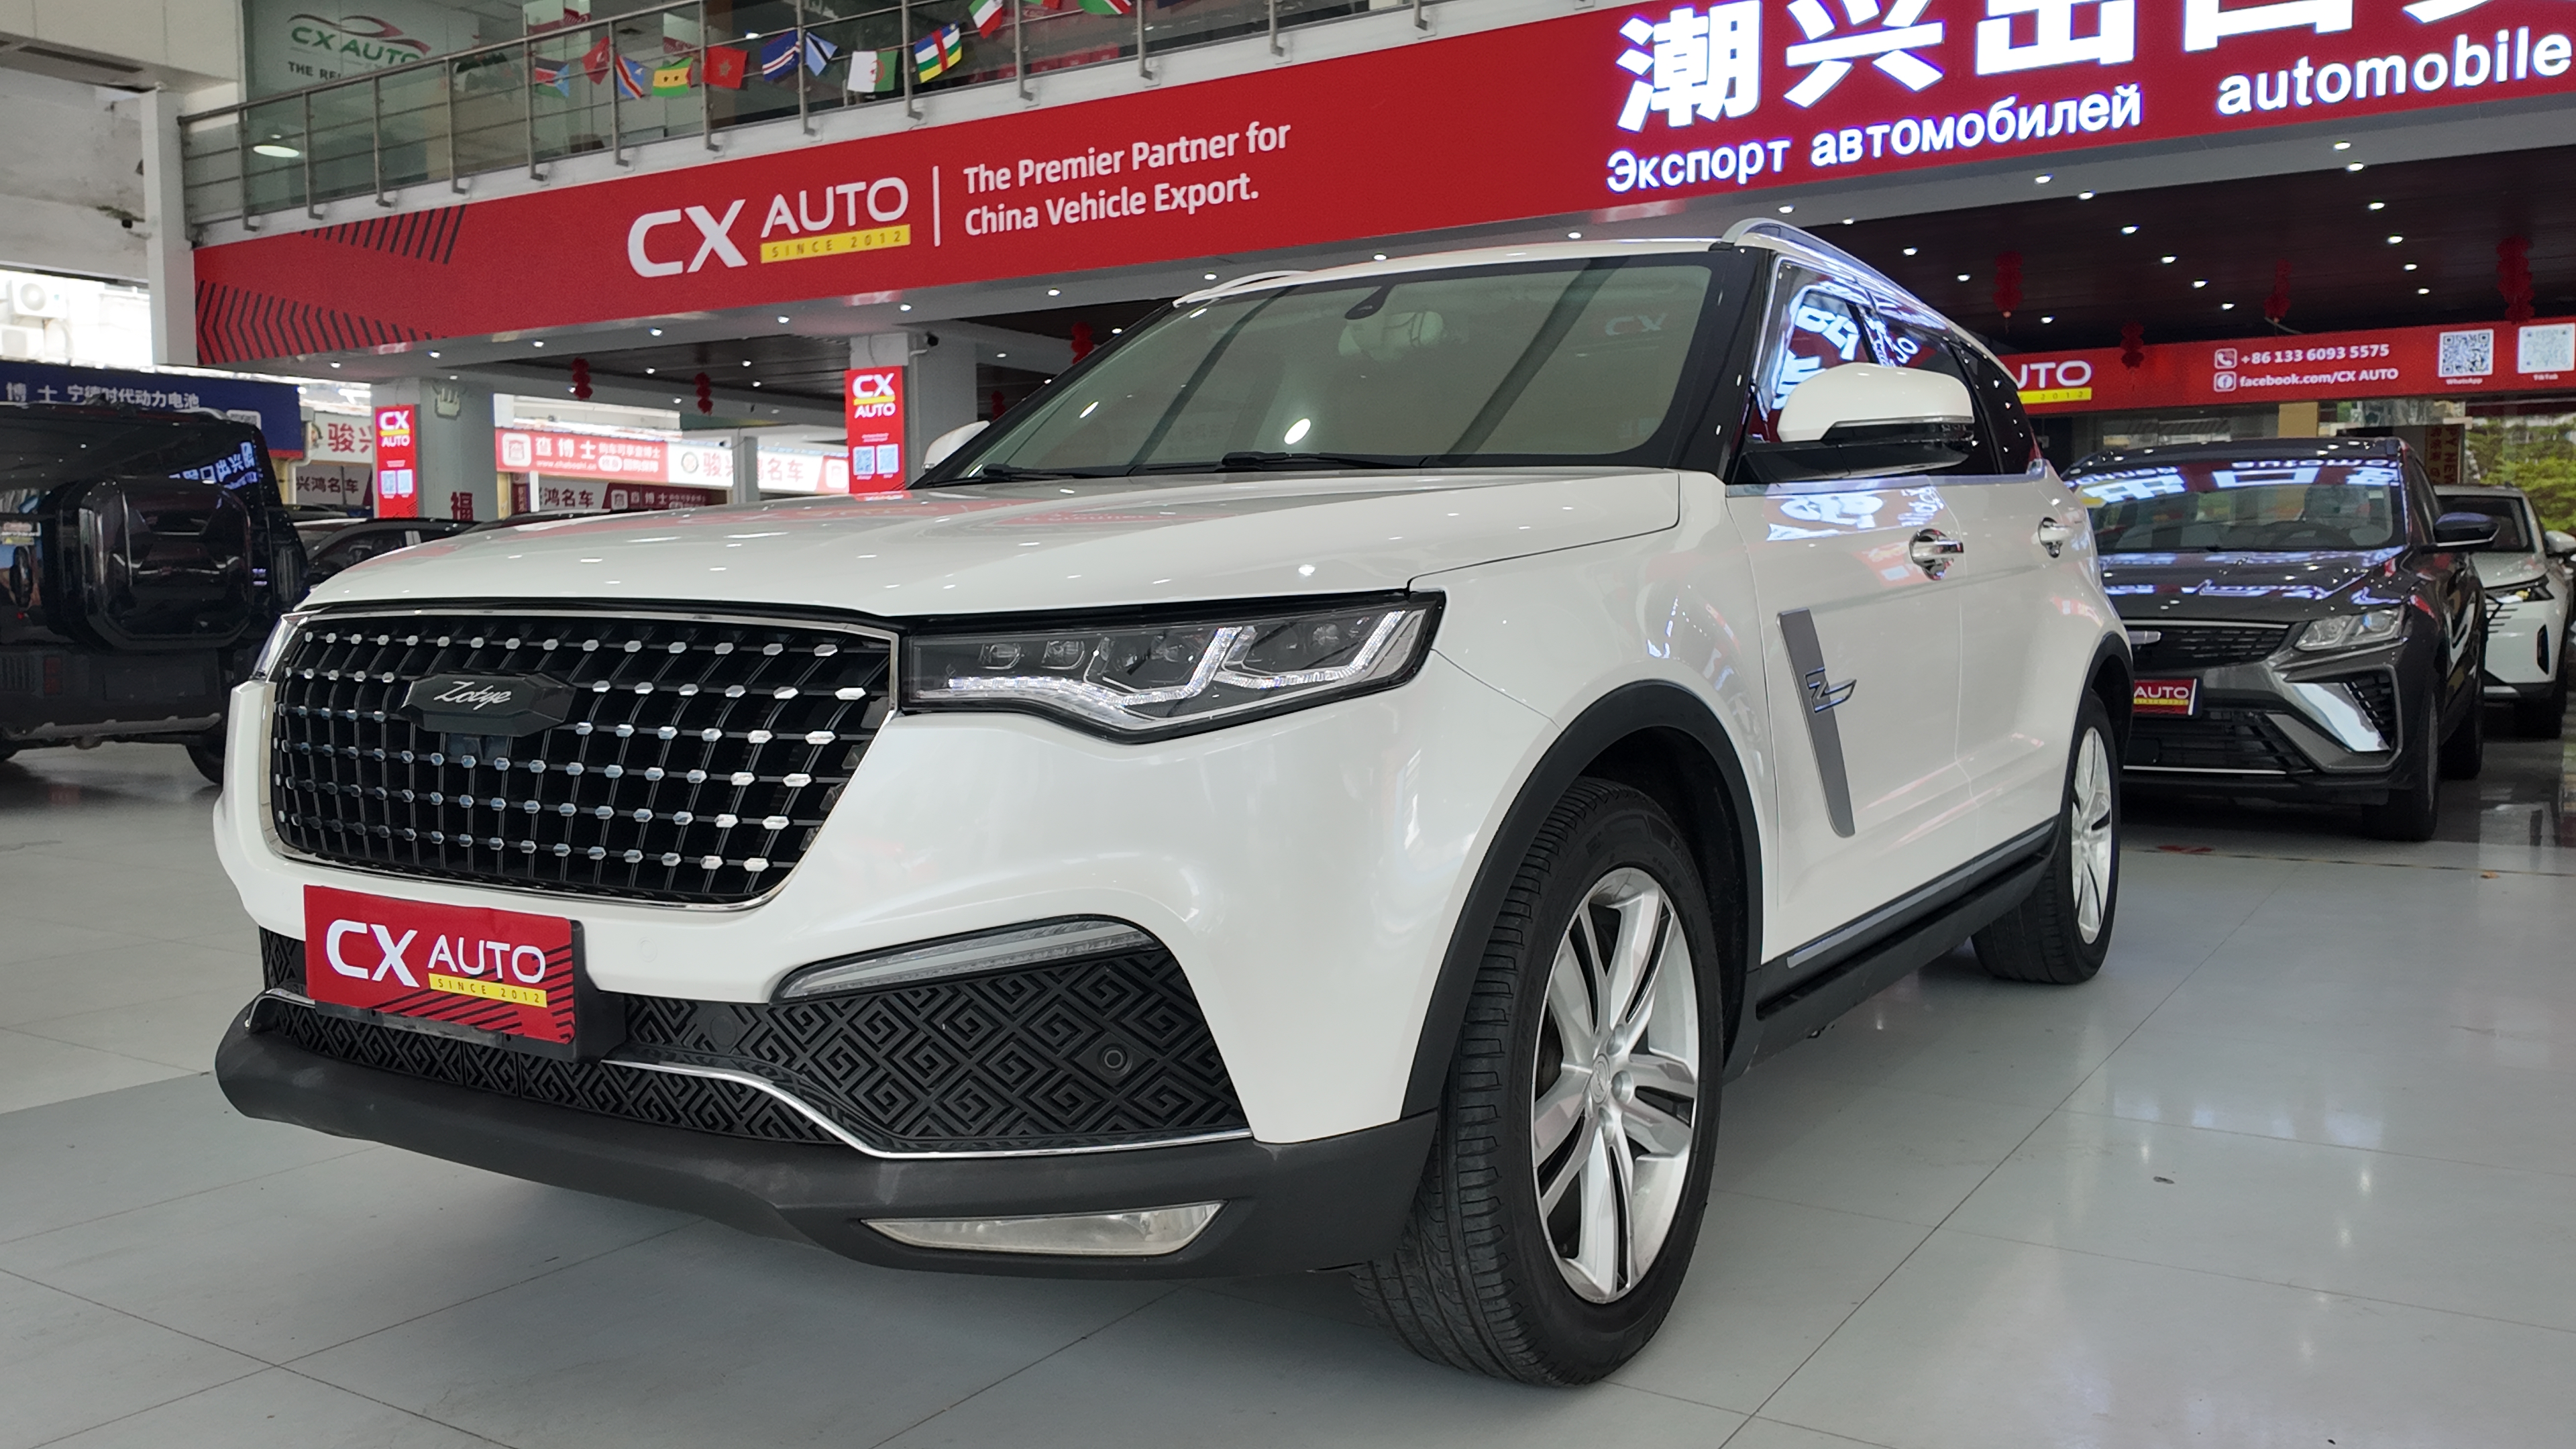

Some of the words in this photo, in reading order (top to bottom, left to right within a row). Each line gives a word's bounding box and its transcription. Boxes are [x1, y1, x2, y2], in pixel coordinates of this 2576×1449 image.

[291, 27, 335, 50] CX
[288, 61, 313, 76] THE
[1615, 0, 2483, 132] 潮兴出
[2217, 26, 2572, 115] automobile
[1607, 138, 1792, 193] Экспорт
[1811, 82, 2142, 166] автомобилей
[963, 164, 1011, 194] The
[1018, 147, 1125, 186] Premier
[1132, 131, 1240, 170] Partner
[1245, 121, 1291, 153] for
[965, 203, 1038, 235] China
[1044, 186, 1146, 225] Vehicle
[1154, 173, 1258, 215] Export.
[628, 199, 748, 277] CX
[761, 176, 908, 237] AUTO
[771, 239, 833, 258] SINCE
[850, 230, 902, 248] 2012
[2241, 352, 2271, 364] +86
[2274, 350, 2303, 363] 133
[2306, 347, 2346, 361] 6093
[2349, 343, 2390, 358] 5575
[852, 373, 895, 398] CX
[2239, 370, 2355, 387] facebook.com/CX
[2359, 368, 2399, 381] AUTO
[379, 411, 409, 430] CX
[854, 402, 896, 419] AUTO
[382, 435, 410, 447] AUTO
[539, 487, 594, 508] 鸿名车
[433, 682, 512, 710] Zotye
[2134, 686, 2189, 699] AUTO
[326, 919, 419, 987] CX
[427, 934, 546, 983] AUTO
[437, 978, 488, 996] SINCE
[500, 987, 541, 1004] 2012
